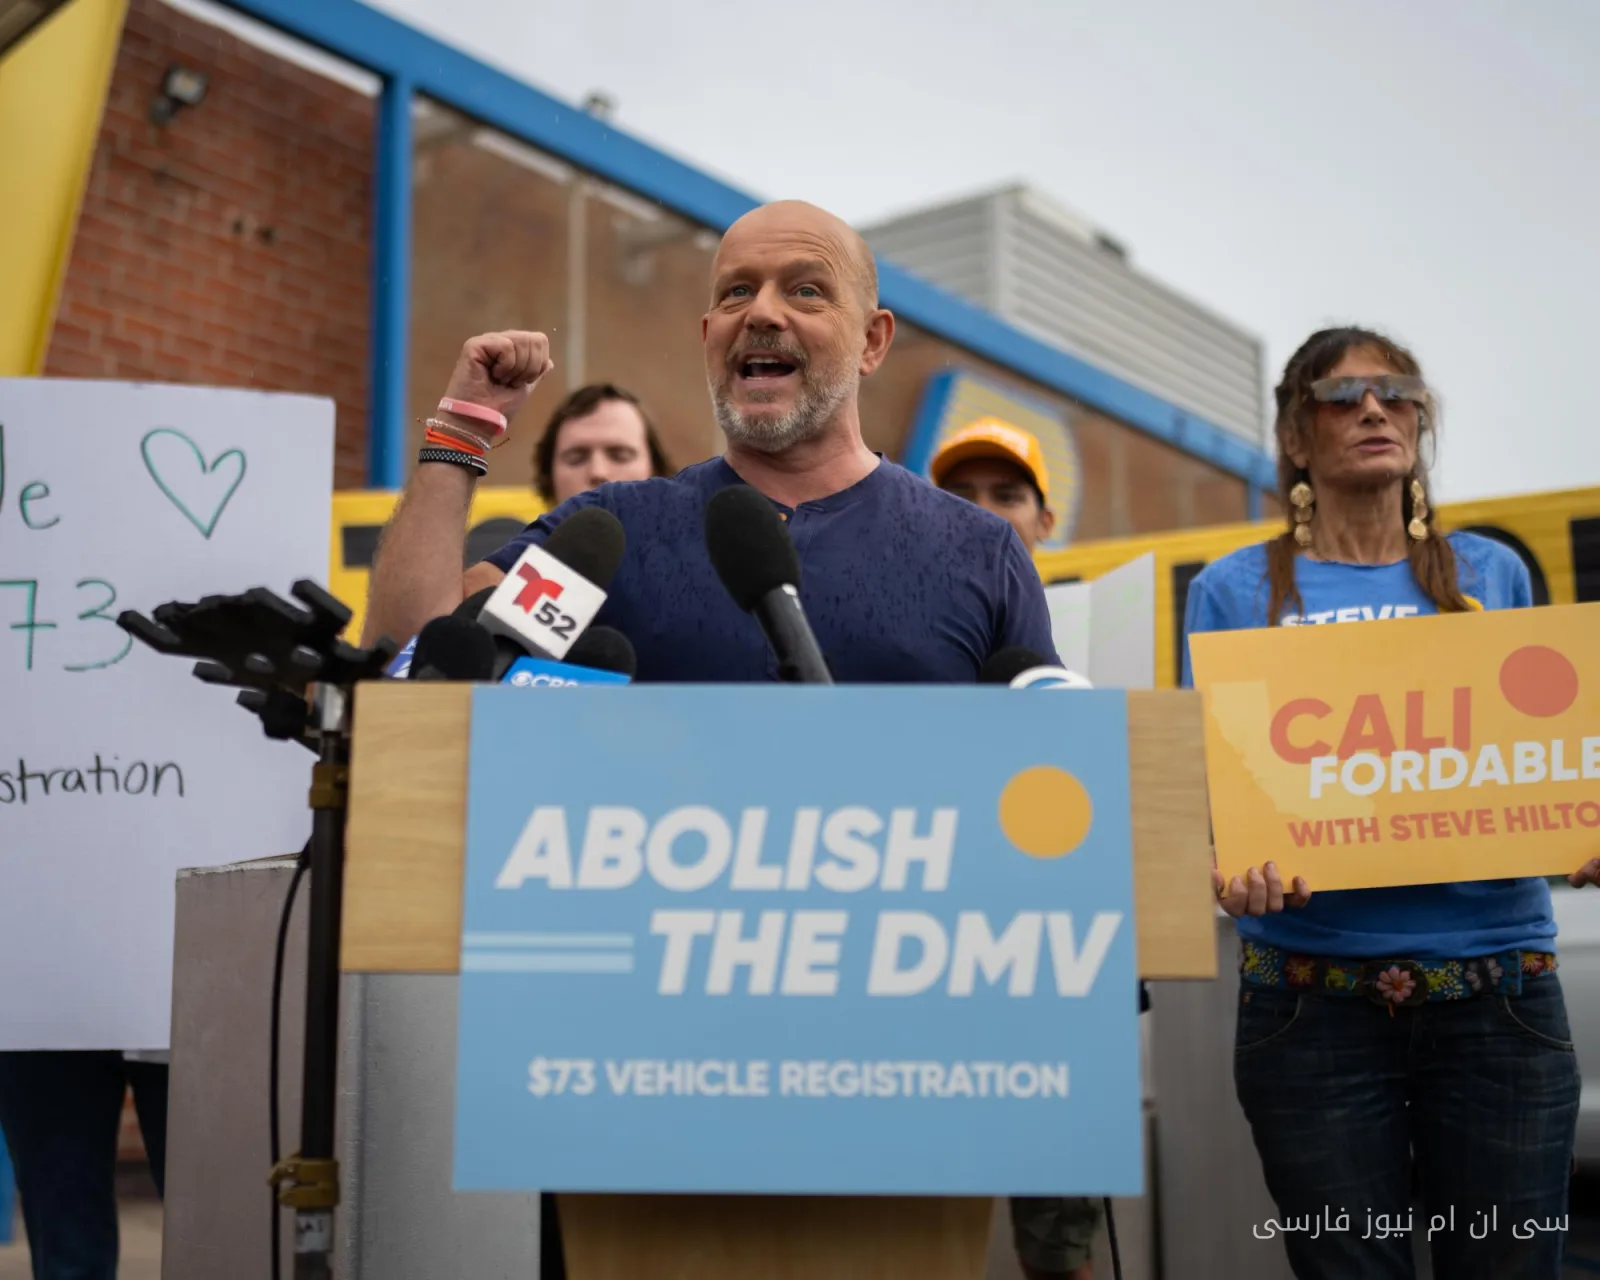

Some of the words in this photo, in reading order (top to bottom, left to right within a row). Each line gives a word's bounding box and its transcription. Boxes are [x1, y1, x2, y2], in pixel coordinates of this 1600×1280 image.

[534, 602, 577, 641] 52
[1269, 686, 1472, 764] CALI
[0, 753, 184, 804] stration
[1308, 735, 1600, 799] FORDABLE
[494, 804, 959, 893] ABOLISH
[1287, 815, 1381, 849] WITH
[1389, 808, 1497, 842] STEVE
[1503, 800, 1600, 834] HILTO
[650, 909, 850, 996] THE
[866, 910, 1123, 998] DMV
[526, 1055, 597, 1098] $73
[605, 1058, 770, 1098] VEHICLE
[779, 1060, 1070, 1099] REGISTRATION
